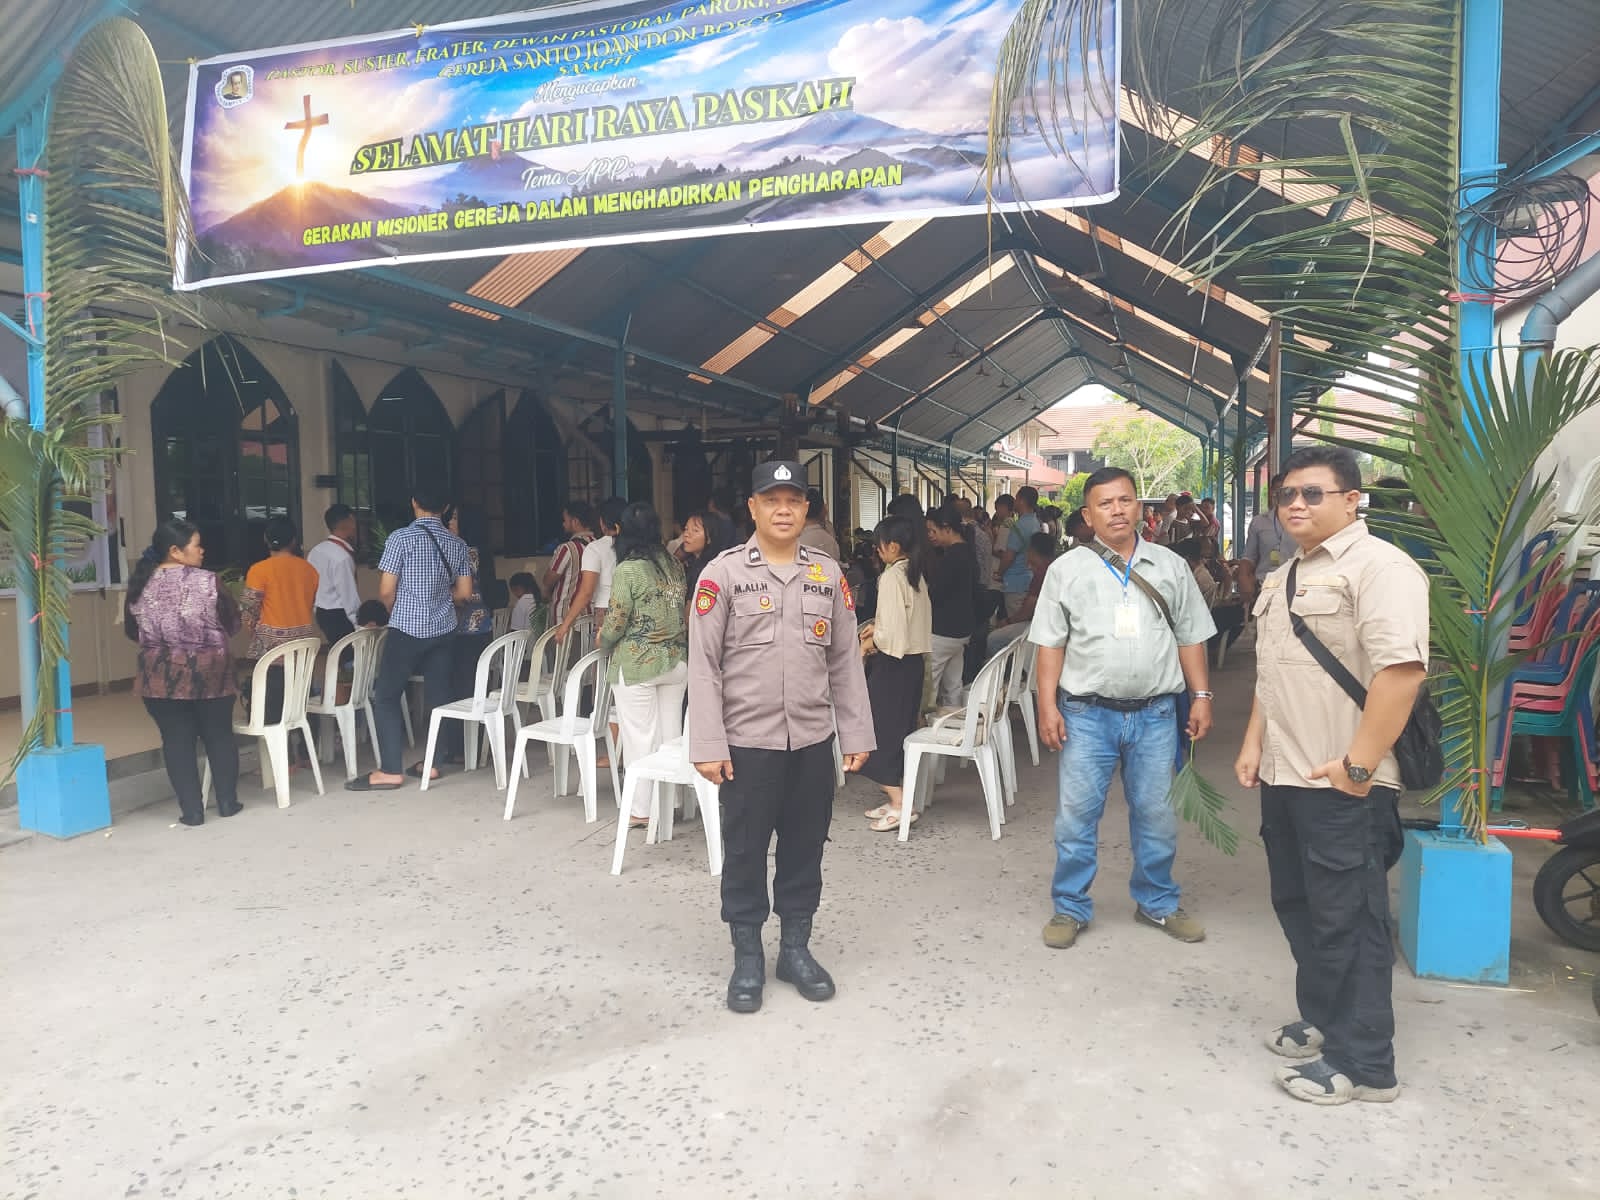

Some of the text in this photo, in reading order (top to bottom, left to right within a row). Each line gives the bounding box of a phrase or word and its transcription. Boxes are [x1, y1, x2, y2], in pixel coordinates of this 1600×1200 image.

[342, 51, 411, 75] SUSTER,
[415, 40, 487, 64] FRATER,
[493, 33, 567, 50] DEWAN
[571, 11, 673, 41] PASTORAL
[438, 12, 783, 78] GEREJA SANTO JOAN DON BOSCO
[532, 74, 638, 105] Mengucapkan
[352, 78, 854, 174] SELAMAT HARI RAYA PASKAH
[303, 164, 903, 246] GERAKAN MISIONER GEREJA DALAM MENGHADIRKAN PENGHARAPAN
[521, 165, 562, 192] Tema
[803, 583, 833, 597] POLRI
